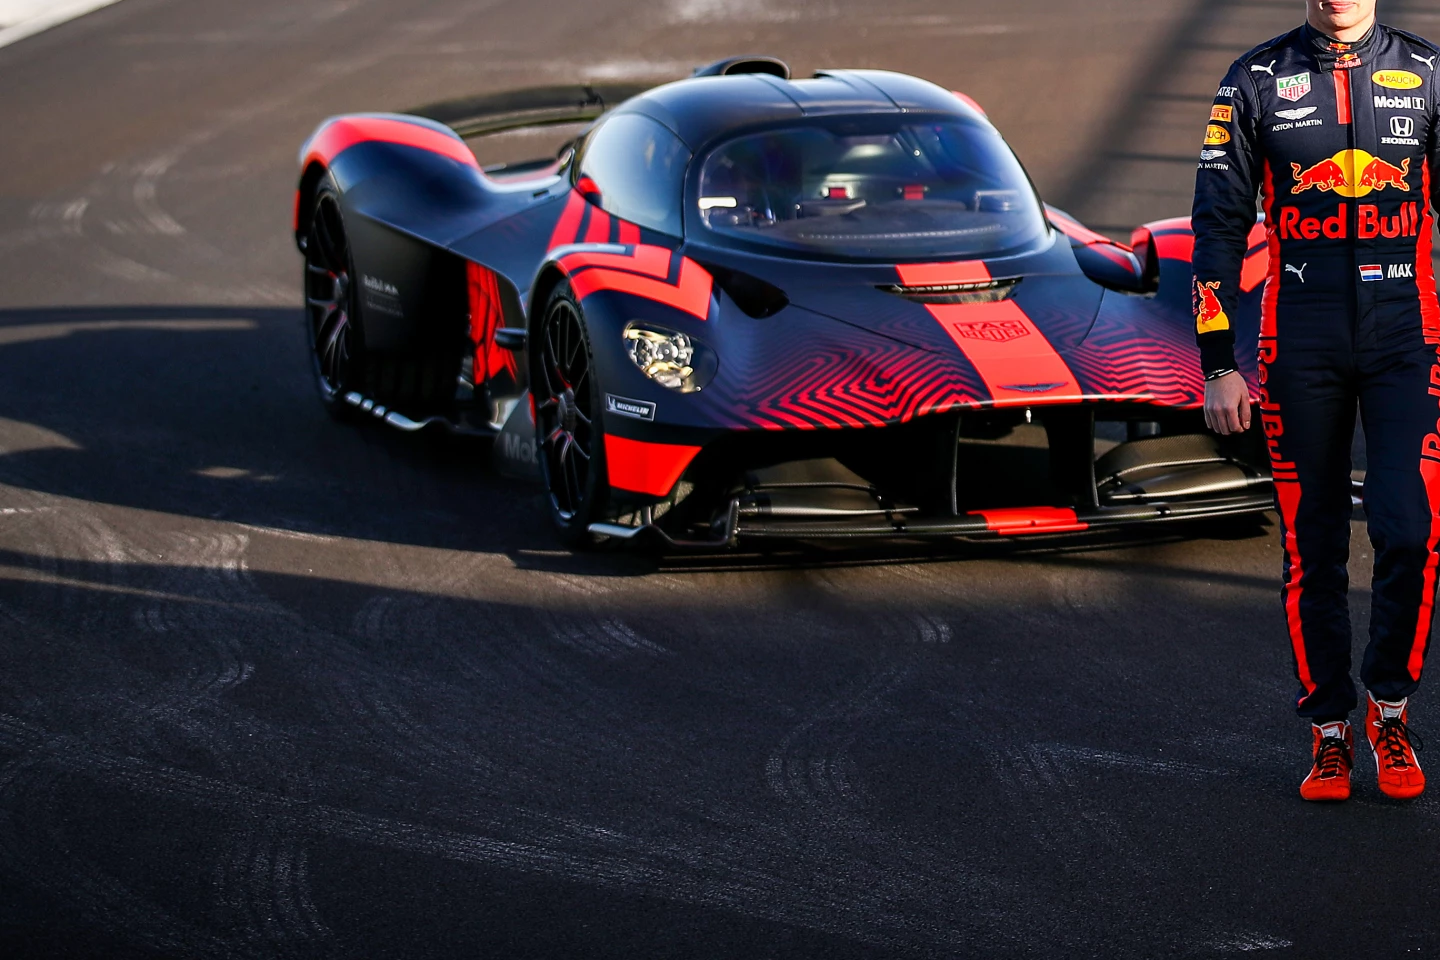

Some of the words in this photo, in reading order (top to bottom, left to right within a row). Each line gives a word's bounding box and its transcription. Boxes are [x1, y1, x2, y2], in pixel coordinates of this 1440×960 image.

[1280, 73, 1307, 88] TAG
[1385, 73, 1416, 85] RAUCH
[1217, 86, 1238, 98] AT&T
[1279, 83, 1310, 100] HEUER
[1374, 95, 1411, 109] Mobil
[1272, 123, 1294, 132] ASTON
[1295, 119, 1323, 128] MARTIN
[1381, 137, 1419, 146] HONDA
[1204, 162, 1229, 171] MARTIN
[1280, 203, 1348, 240] Red
[1358, 201, 1417, 240] Bull
[1387, 263, 1413, 279] MAX
[616, 402, 650, 416] MICHELIN
